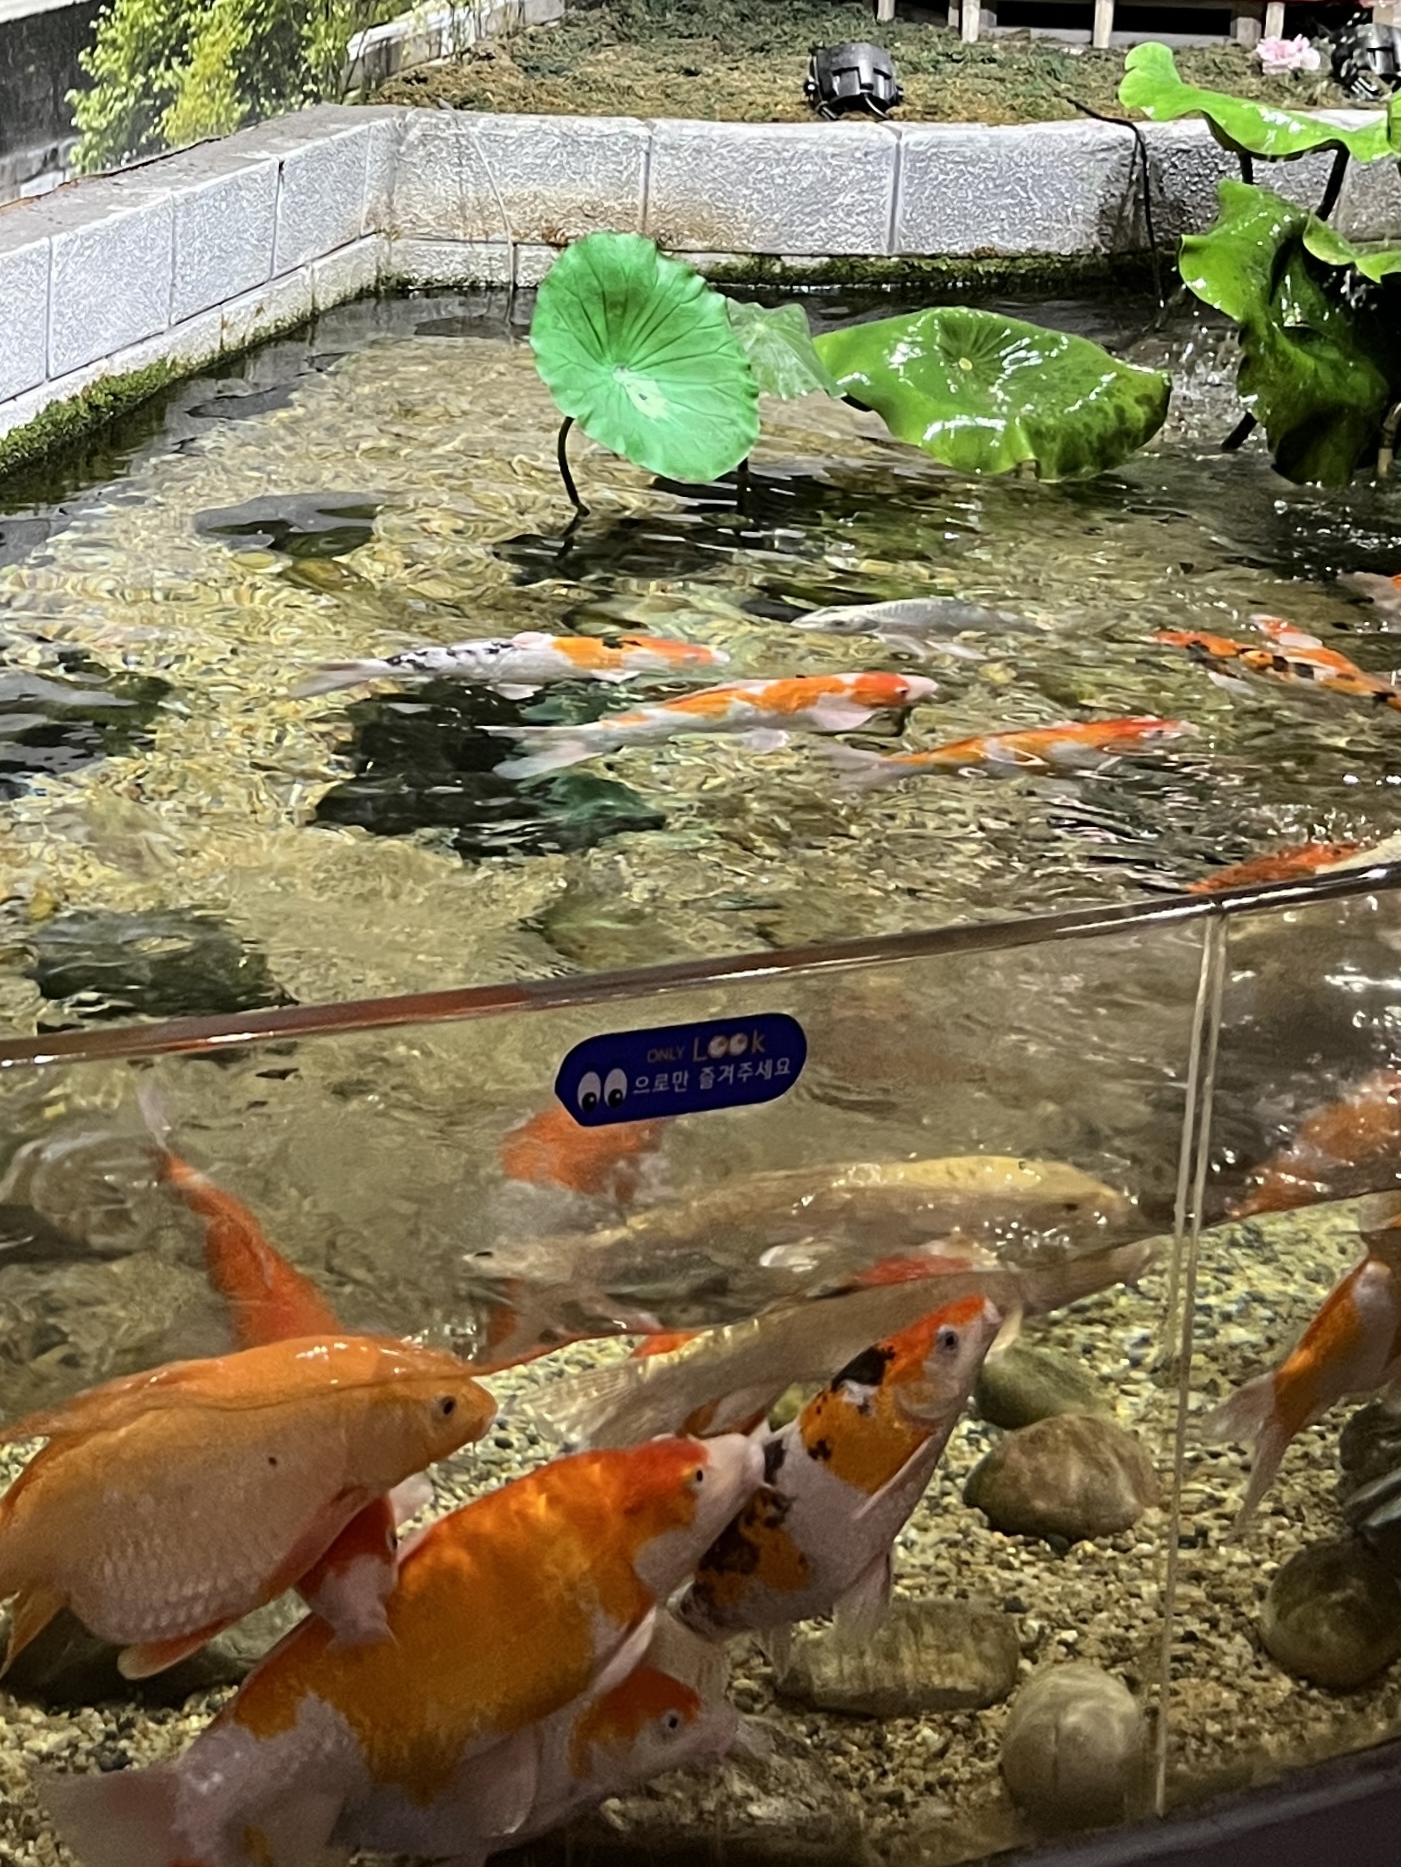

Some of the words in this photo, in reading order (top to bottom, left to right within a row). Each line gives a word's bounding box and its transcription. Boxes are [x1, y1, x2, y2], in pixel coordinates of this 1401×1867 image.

[647, 1046, 685, 1063] ONLY
[633, 1071, 688, 1094] 으로만
[699, 1057, 791, 1090] 즐겨주세요
